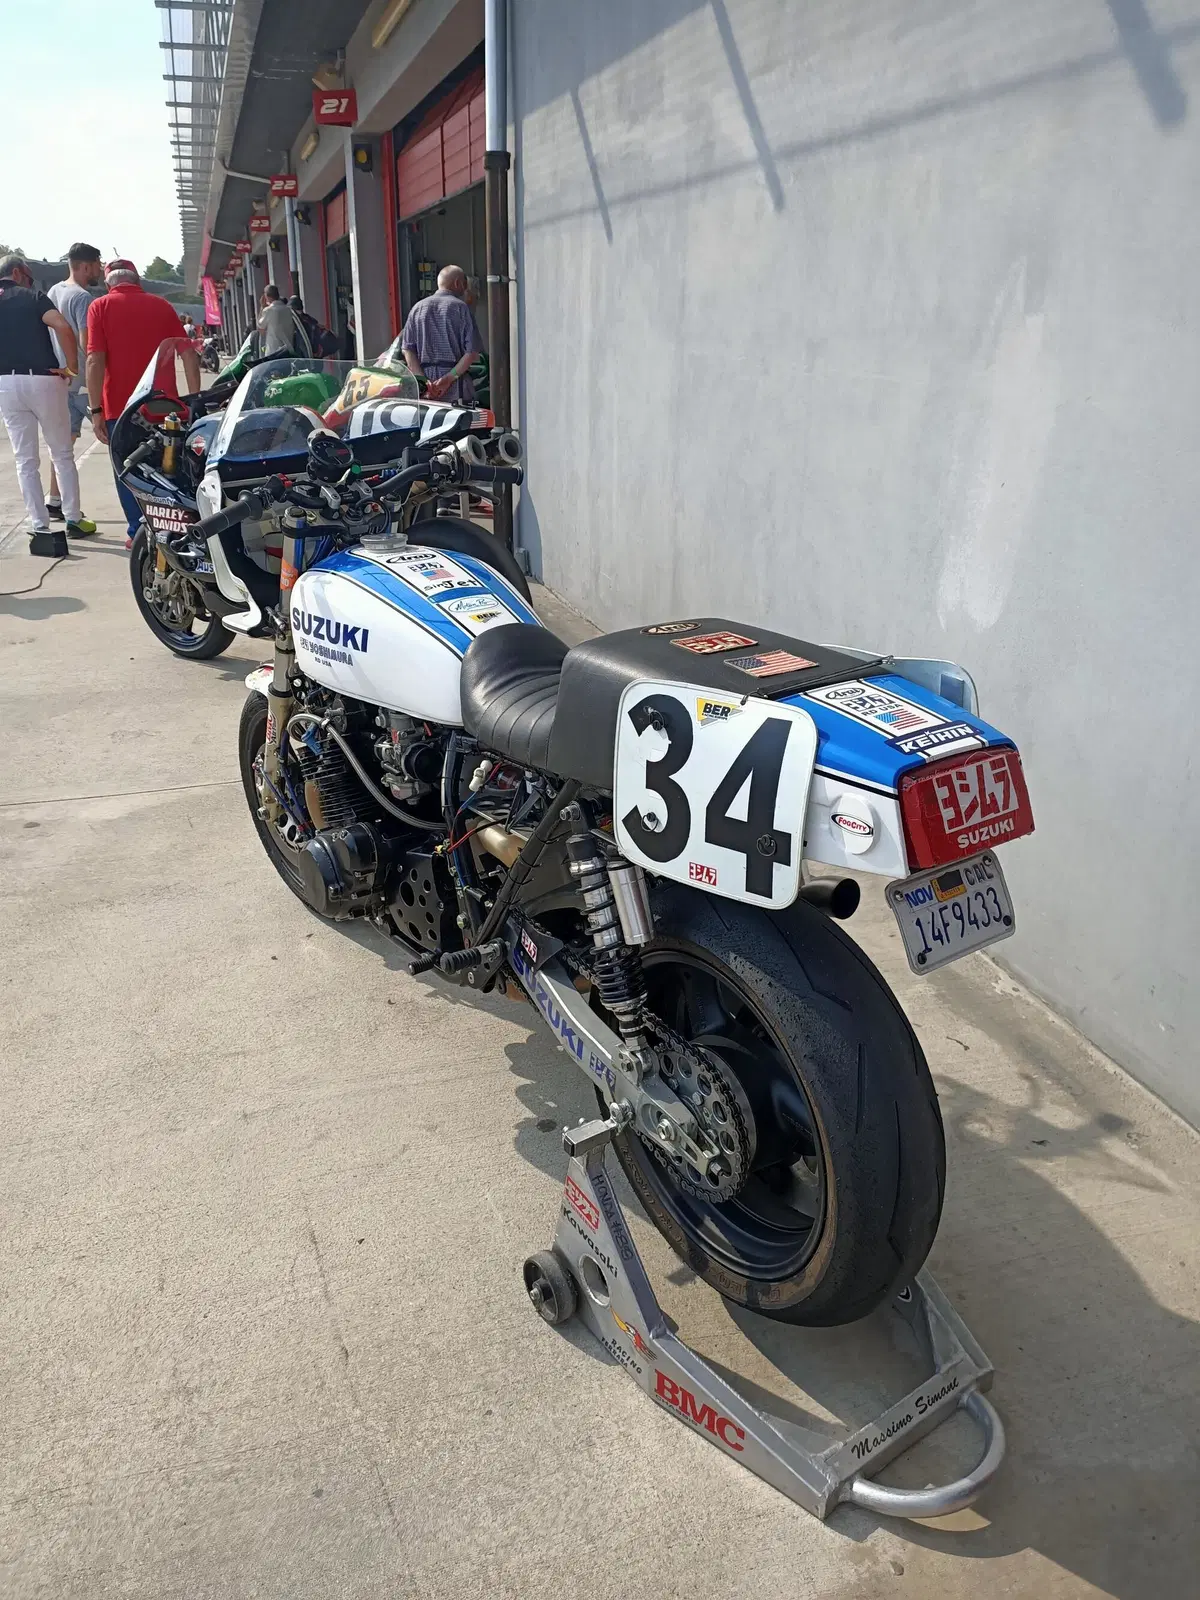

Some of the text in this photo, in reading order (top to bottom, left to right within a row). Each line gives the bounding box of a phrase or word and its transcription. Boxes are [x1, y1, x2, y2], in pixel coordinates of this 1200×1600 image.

[320, 98, 348, 114] 21
[272, 180, 296, 191] 22
[251, 219, 270, 227] 23
[146, 504, 189, 521] HARLEY-
[153, 518, 194, 534] DAVIDS
[292, 607, 369, 653] SUZUKI
[309, 641, 354, 667] YOSHIMURA
[825, 687, 866, 700] Arai
[703, 702, 731, 718] BER
[861, 703, 904, 717] RD USA
[897, 725, 974, 753] KEIHIN
[622, 693, 793, 900] 34
[933, 754, 1019, 834] ヨシムラ
[957, 817, 1014, 849] SUZUKI
[689, 863, 717, 885] ヨシムラ
[904, 884, 934, 908] NOV
[916, 887, 1003, 953] 14F9433
[513, 948, 584, 1061] SUZUKI
[563, 1207, 618, 1278] Kawasaki
[611, 1338, 642, 1374] RACING
[654, 1368, 745, 1452] BMC
[851, 1413, 914, 1459] Massimo
